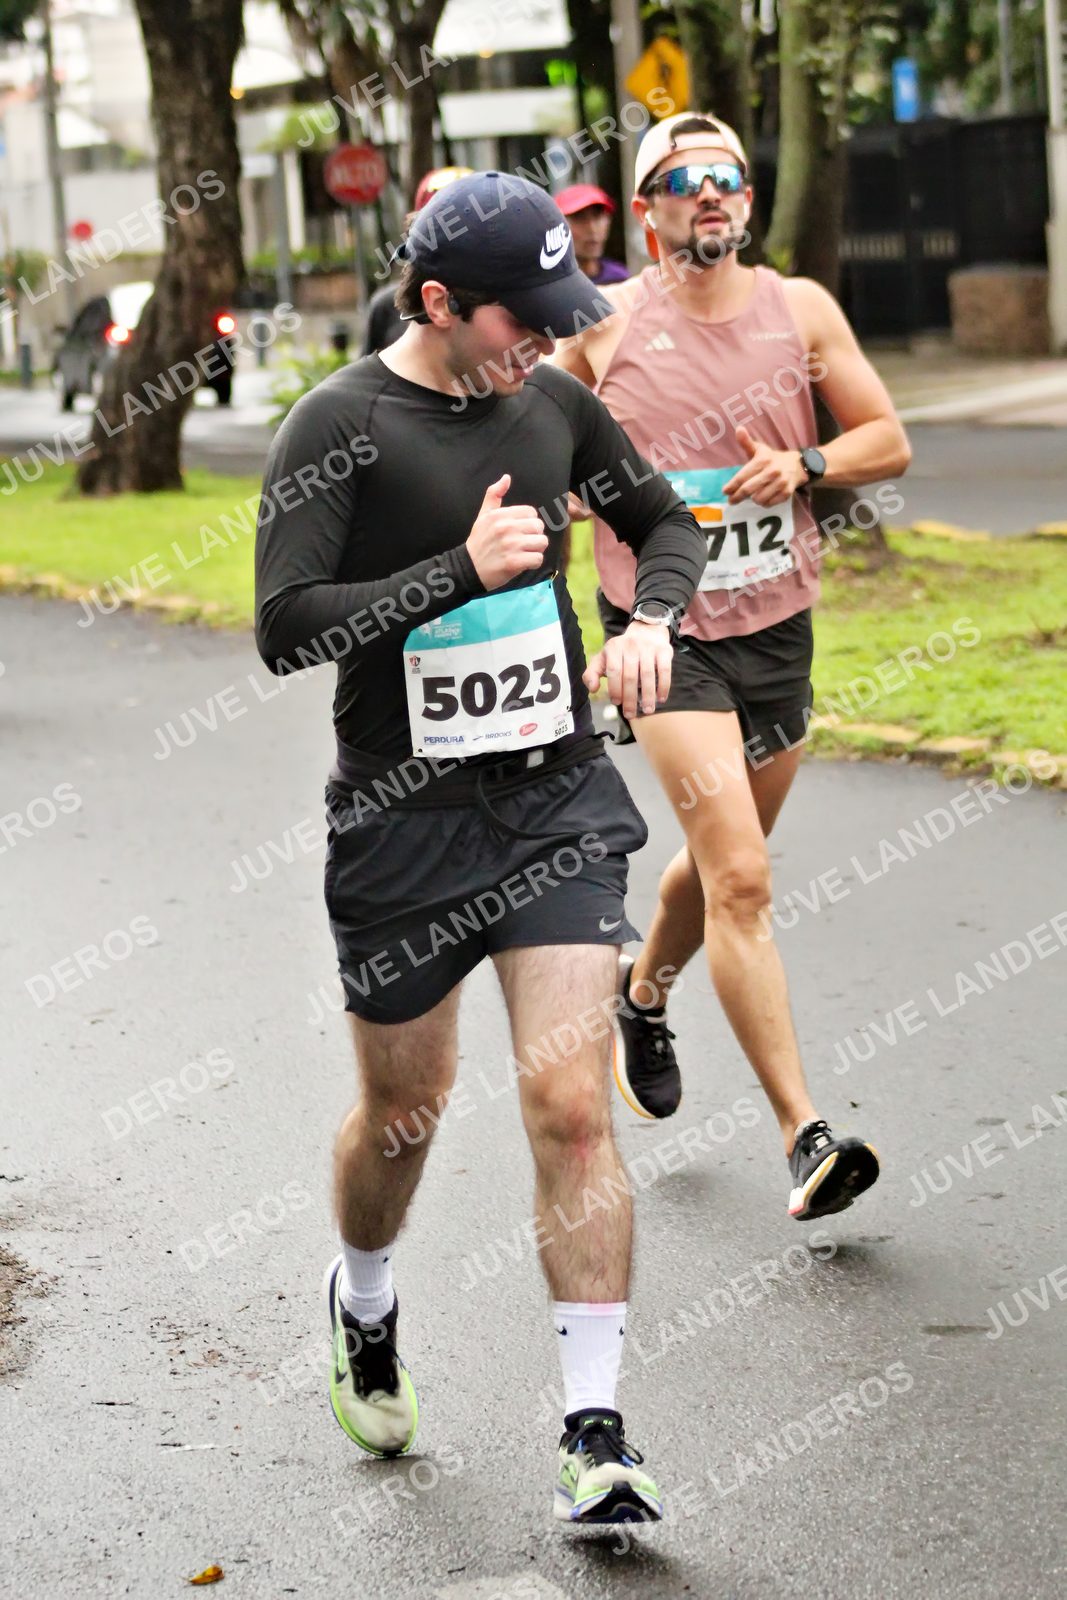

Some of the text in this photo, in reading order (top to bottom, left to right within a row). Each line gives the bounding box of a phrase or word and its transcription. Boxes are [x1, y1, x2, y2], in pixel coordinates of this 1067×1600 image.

[546, 222, 568, 252] NIKE
[421, 654, 561, 721] 5023
[424, 735, 465, 744] PERDURA
[485, 731, 512, 740] BROOKS
